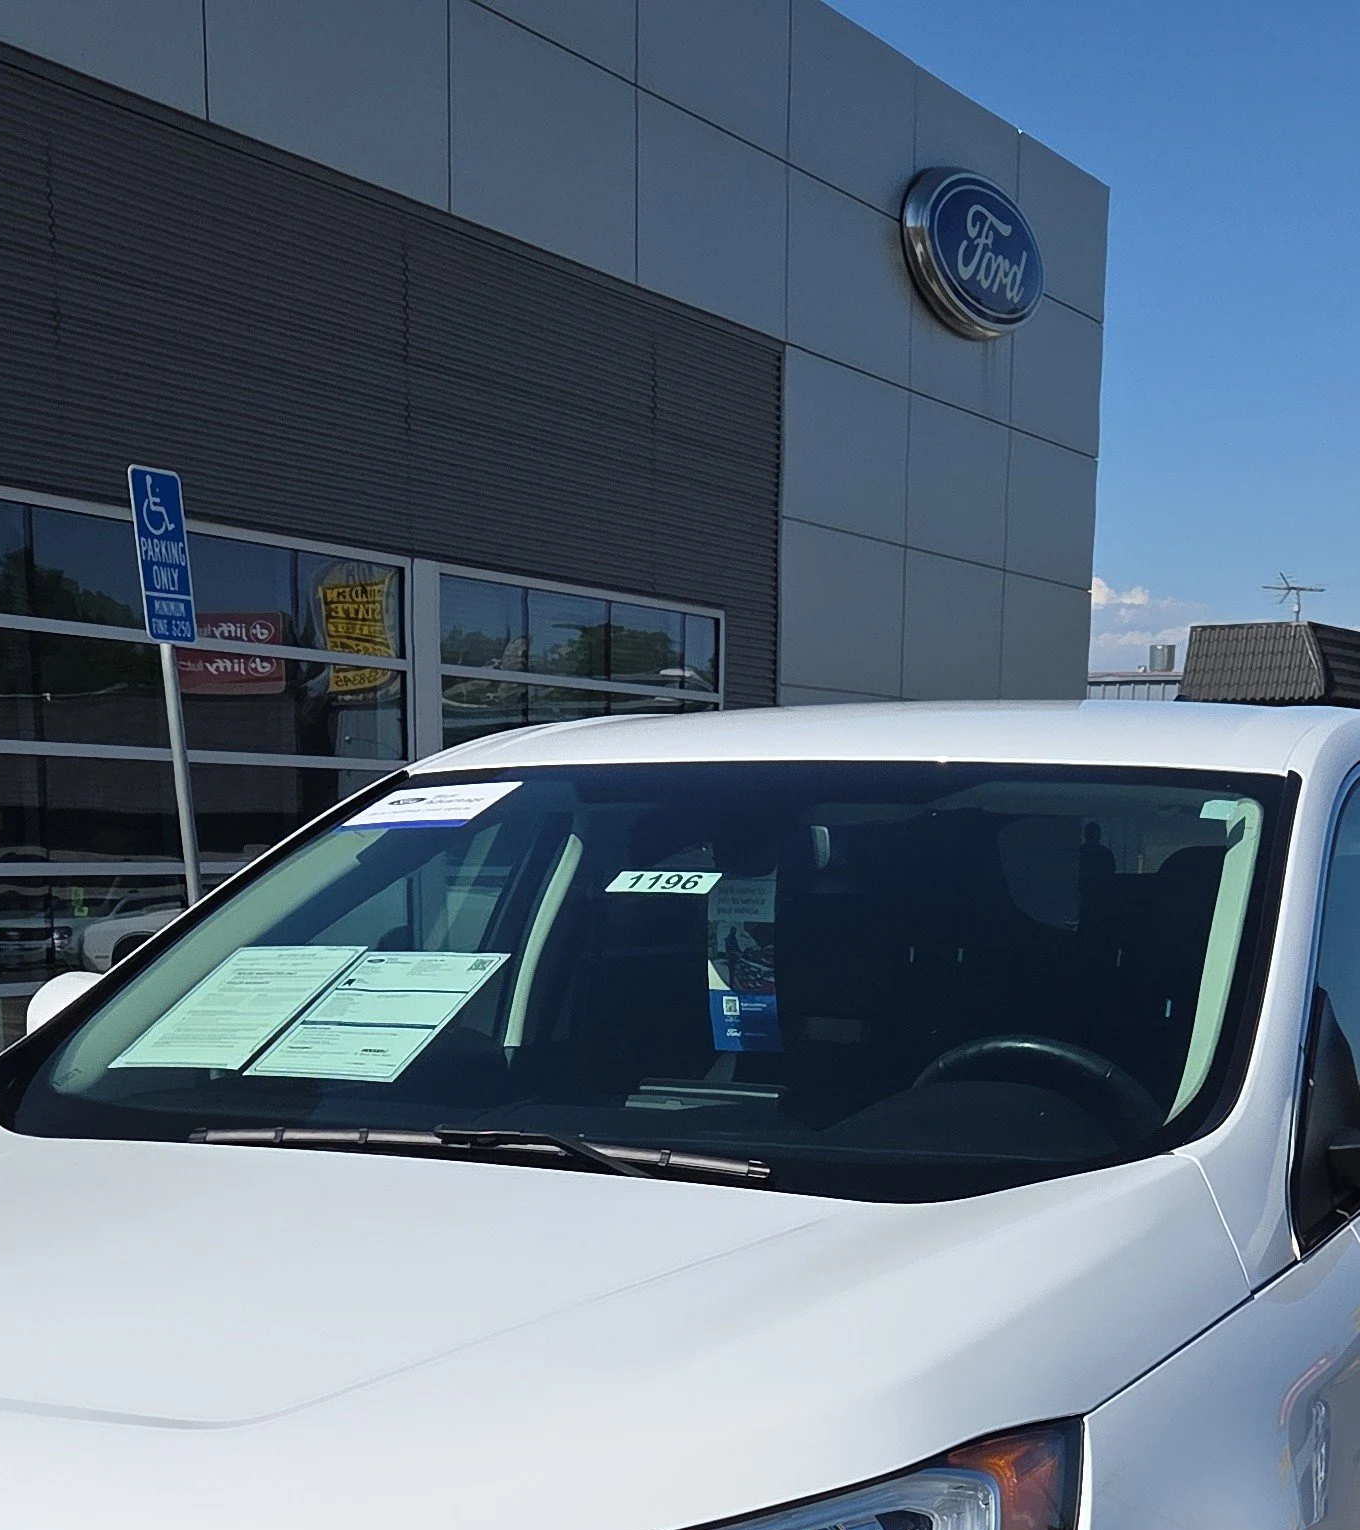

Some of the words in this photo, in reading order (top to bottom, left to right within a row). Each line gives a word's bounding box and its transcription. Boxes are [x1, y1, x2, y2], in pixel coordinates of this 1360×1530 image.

[957, 204, 1028, 305] Ford
[140, 537, 186, 566] PARKING
[152, 565, 180, 592] ONLY
[151, 618, 169, 636] FINE
[171, 619, 192, 638] $250
[628, 873, 704, 890] 1196
